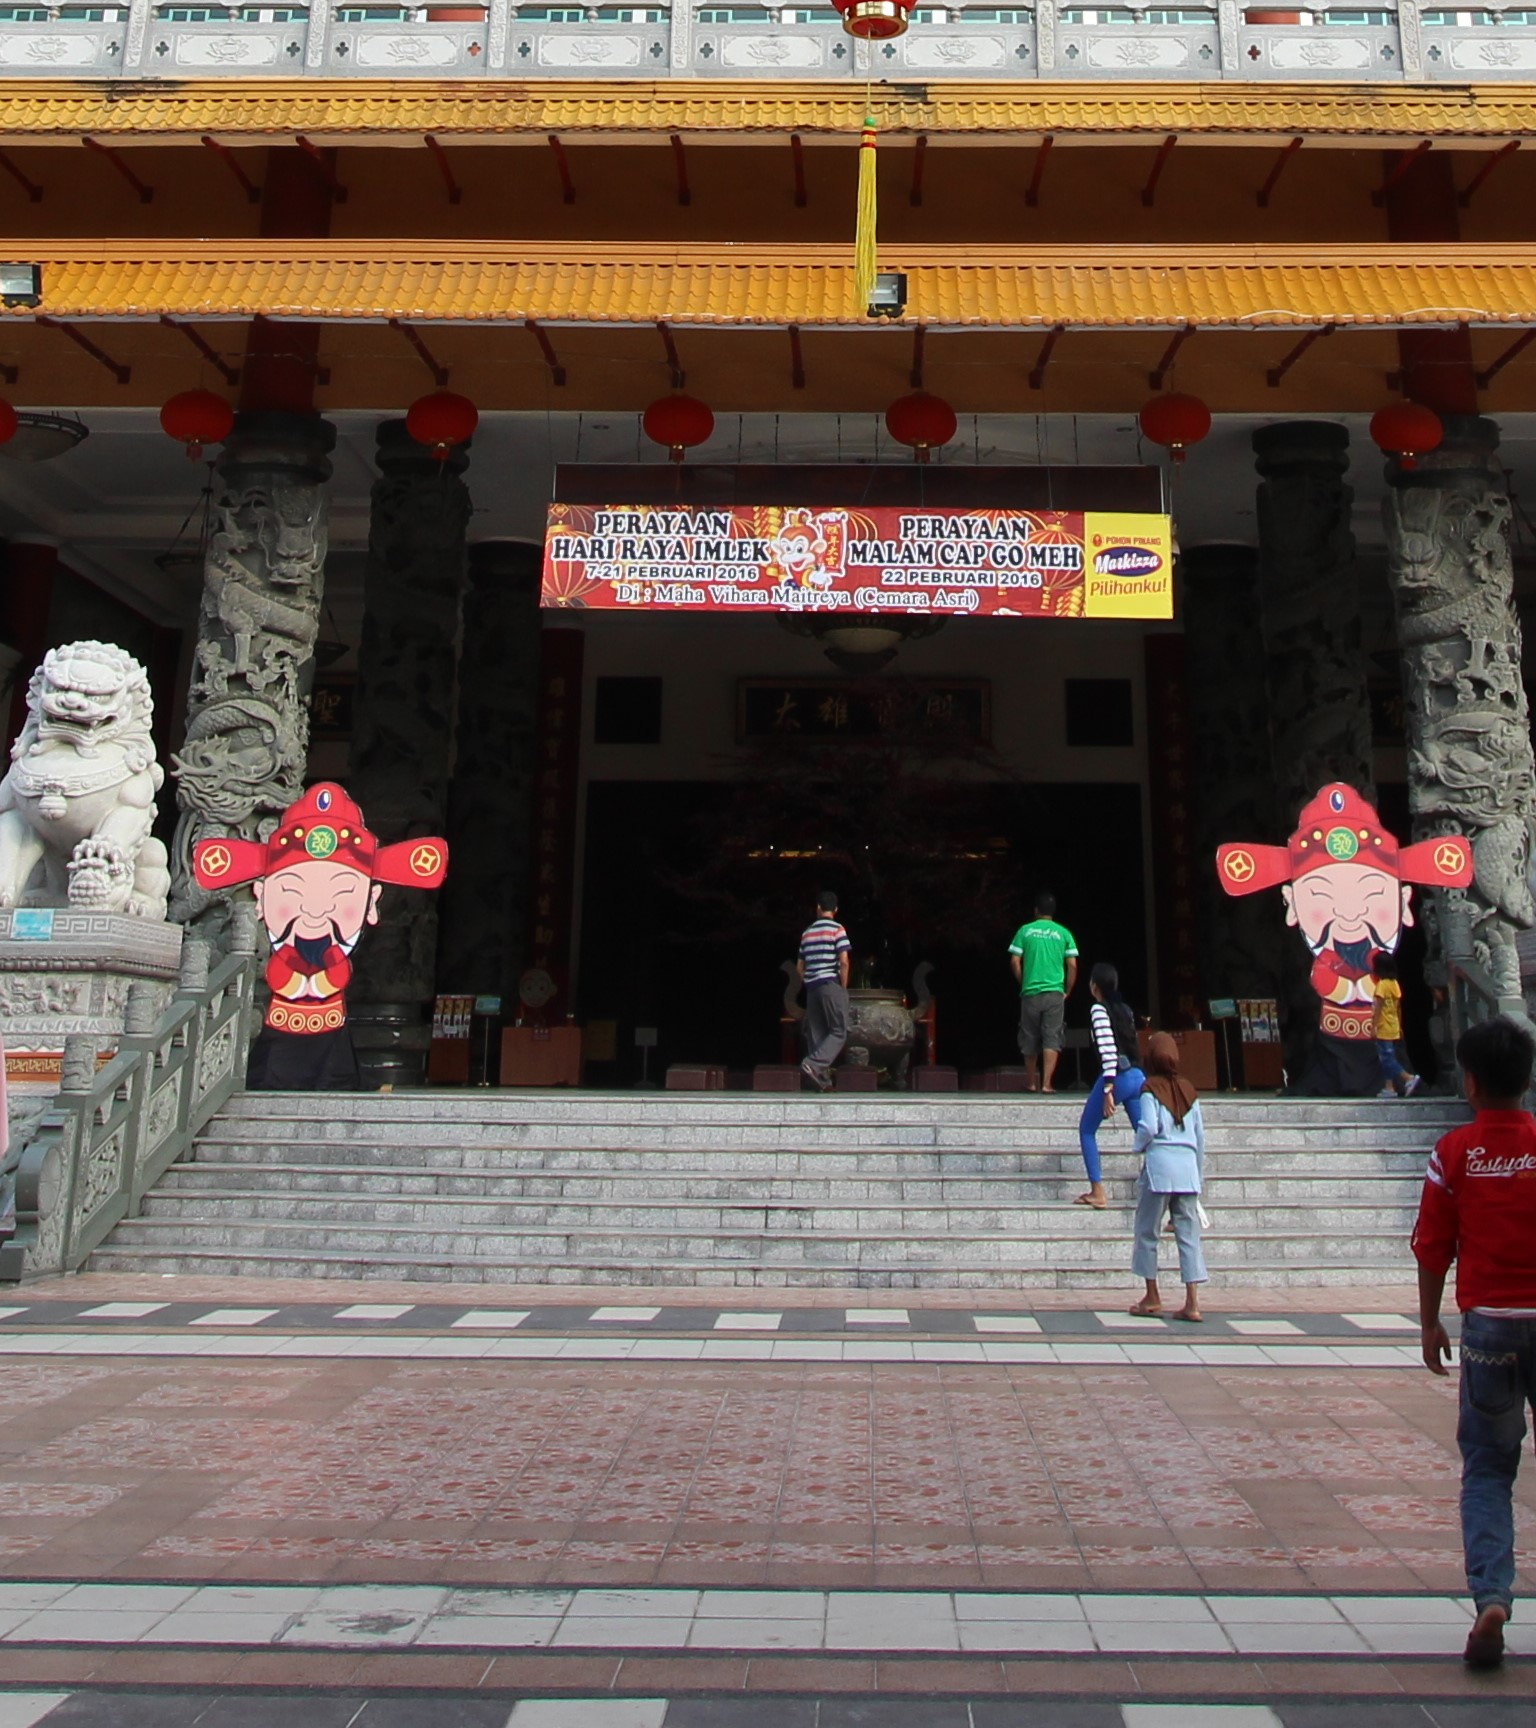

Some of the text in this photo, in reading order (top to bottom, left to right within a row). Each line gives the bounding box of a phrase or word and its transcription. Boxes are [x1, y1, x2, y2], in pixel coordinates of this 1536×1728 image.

[595, 512, 731, 537] PERAYAAN
[901, 517, 1030, 541] PERAYAAN
[553, 538, 771, 563] HARI RAYA IMLEK
[850, 543, 1081, 568] MALAM CAP GO MEH
[587, 565, 758, 580] 7-21 PEBRUARI 2016
[1094, 553, 1159, 574] Markizza
[883, 570, 1041, 587] 22 PEBRUARI 2016
[1090, 578, 1167, 597] Pilihanku!
[618, 585, 640, 601] Di
[656, 586, 704, 603] Maha
[711, 586, 767, 603] Vihara
[774, 588, 850, 607] Maitreya
[855, 589, 929, 606] (Cemara
[935, 590, 979, 609] Asri)
